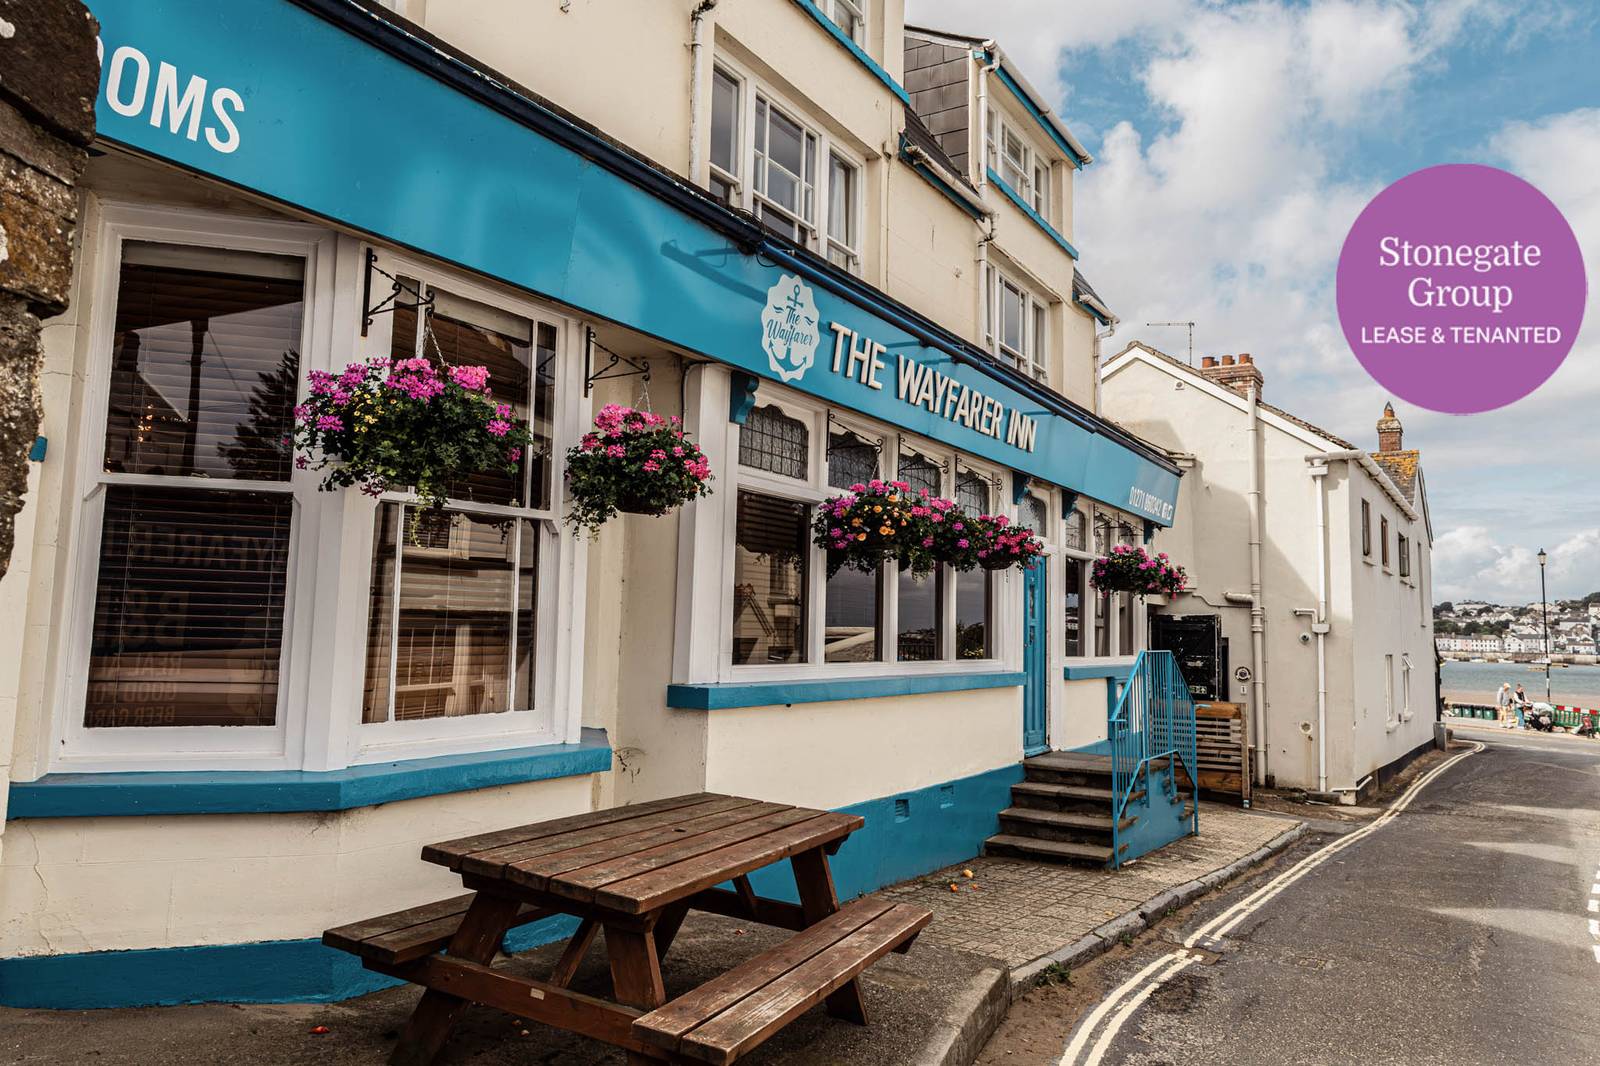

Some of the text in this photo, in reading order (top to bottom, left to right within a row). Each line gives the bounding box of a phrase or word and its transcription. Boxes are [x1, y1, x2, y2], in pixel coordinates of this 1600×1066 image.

[96, 35, 245, 154] OMS
[785, 305, 801, 325] The
[767, 318, 813, 347] Wayfarer
[830, 321, 1038, 453] THE WAYFARER INN
[1129, 485, 1145, 509] 01271
